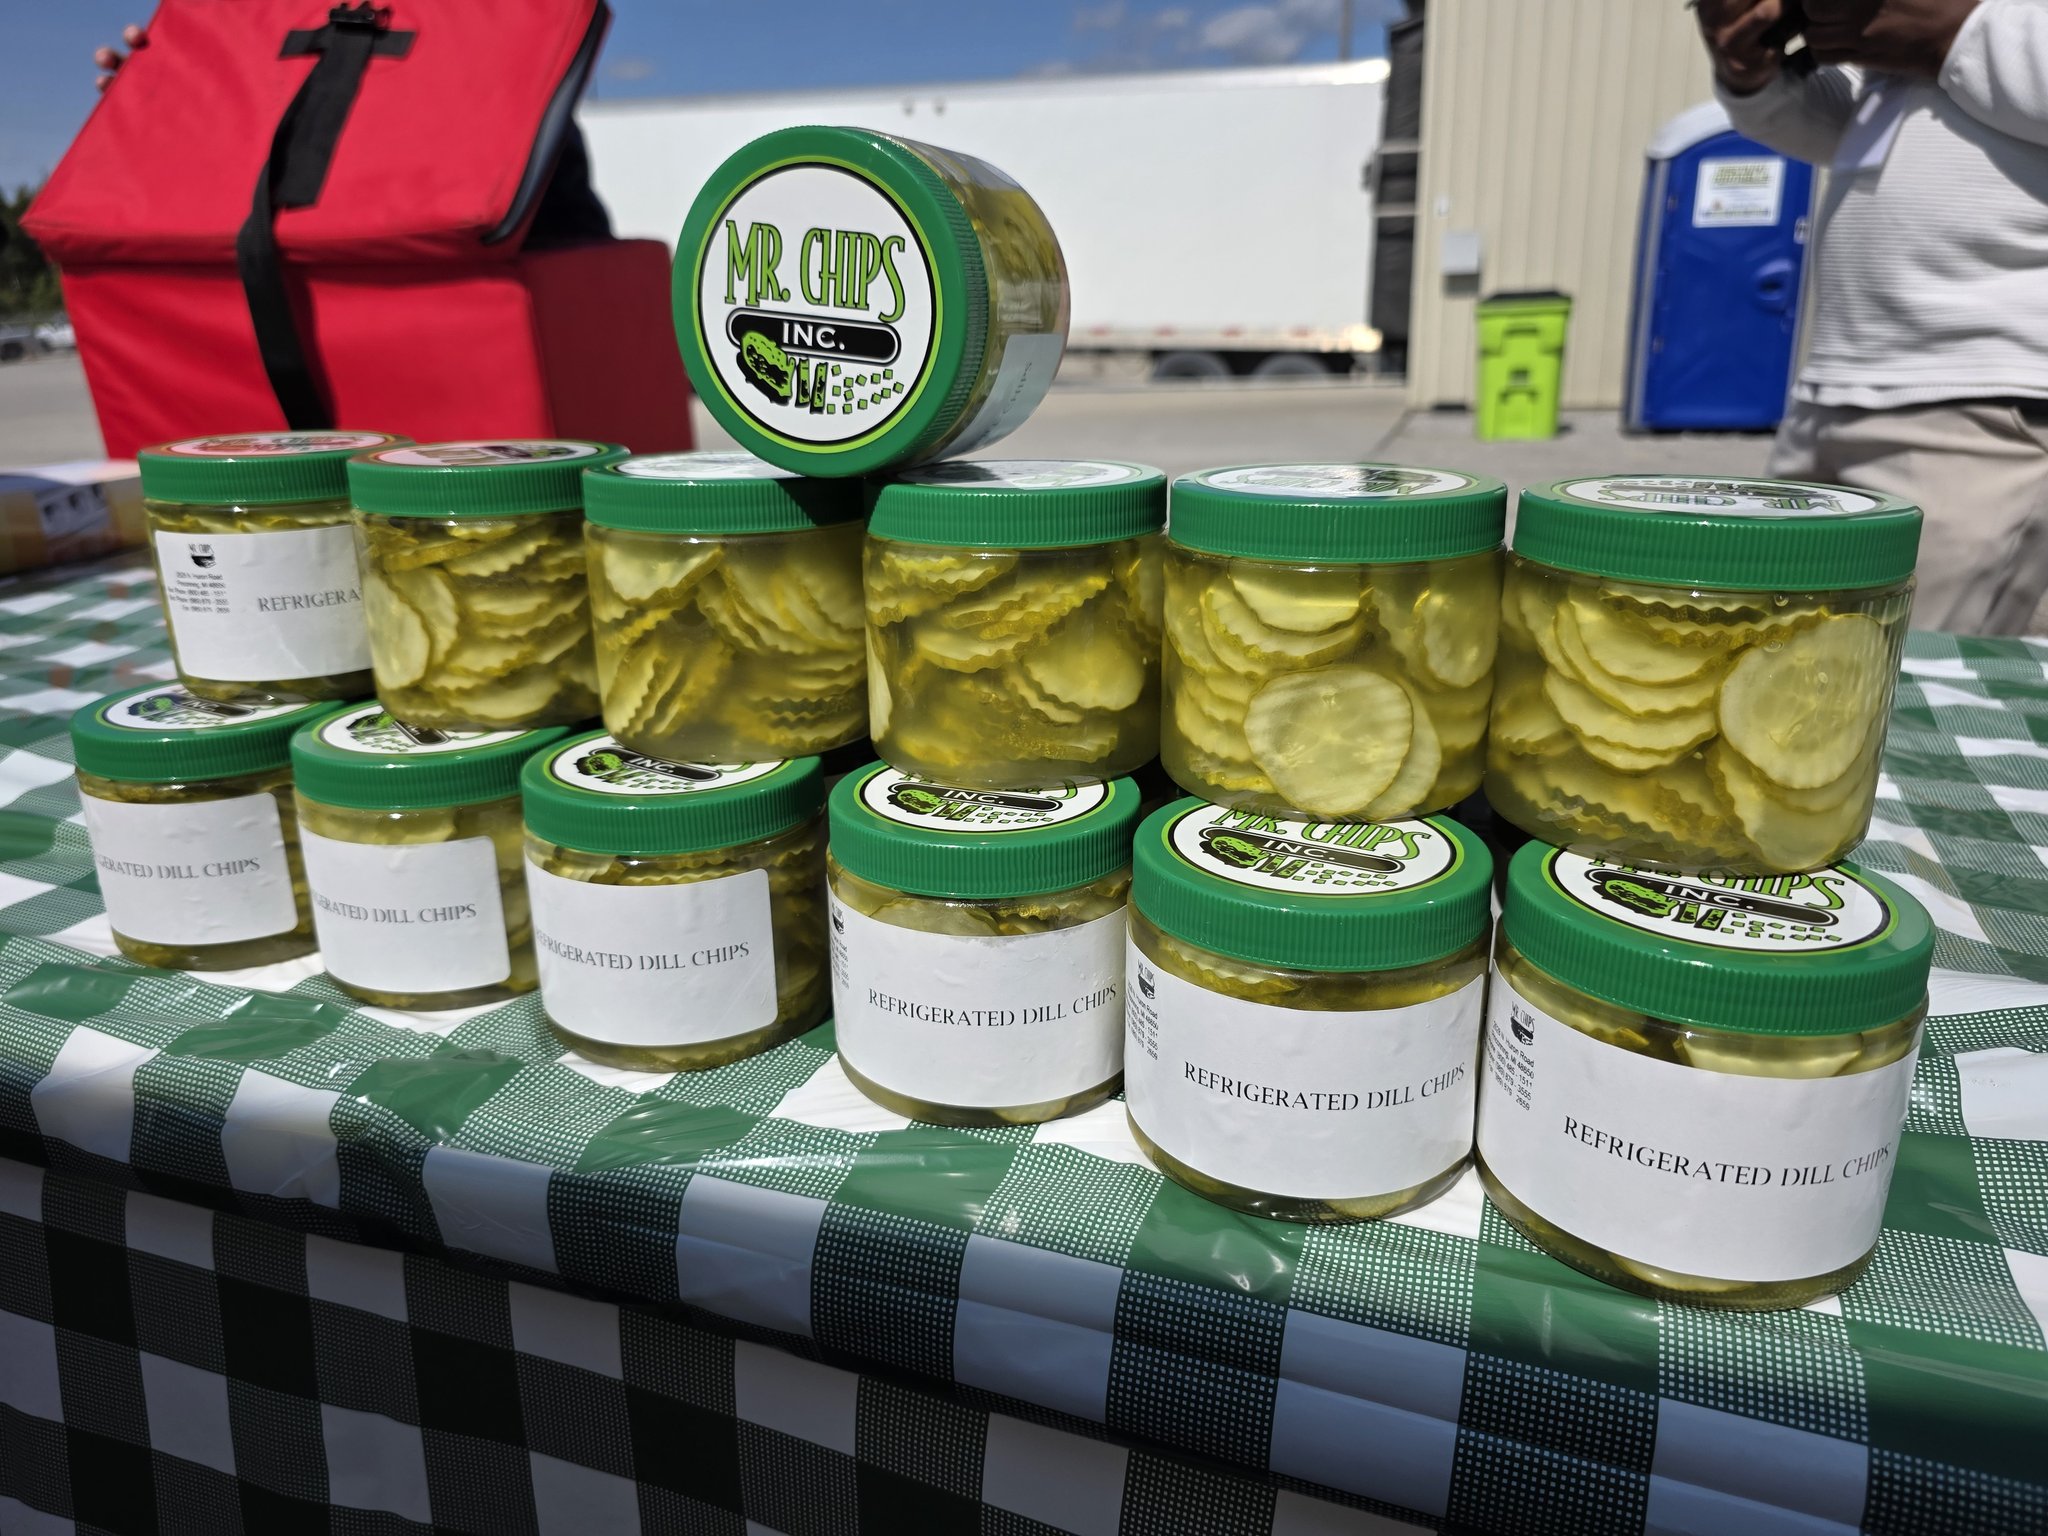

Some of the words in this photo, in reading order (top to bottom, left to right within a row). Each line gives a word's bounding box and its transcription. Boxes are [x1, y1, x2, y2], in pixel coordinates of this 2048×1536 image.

[724, 219, 791, 308] MR.
[800, 227, 907, 323] CHIPS
[782, 322, 846, 351] INC.
[257, 587, 361, 613] REFRIGERA
[629, 757, 676, 773] INC.
[943, 791, 1005, 805] INC.
[1262, 840, 1337, 861] INC.
[1301, 820, 1432, 861] CHIPS
[158, 864, 200, 879] DILL
[203, 856, 261, 878] CHIPS
[1664, 884, 1755, 911] INC.
[373, 908, 415, 924] DILL
[419, 903, 477, 923] CHIPS
[640, 954, 686, 970] DILL
[692, 941, 750, 966] CHIPS
[868, 988, 1015, 1027] REFRIGERATED
[1023, 1003, 1067, 1025] DILL
[1072, 983, 1117, 1014] CHIPS
[1520, 1050, 1535, 1067] Road
[1184, 1061, 1359, 1111] REFRIGERATED
[1367, 1086, 1415, 1110] DILL
[1421, 1061, 1465, 1098] CHIPS
[1563, 1115, 1771, 1186] REFRIGERATED
[1780, 1163, 1835, 1187] DILL
[1843, 1142, 1891, 1179] CHIPS
